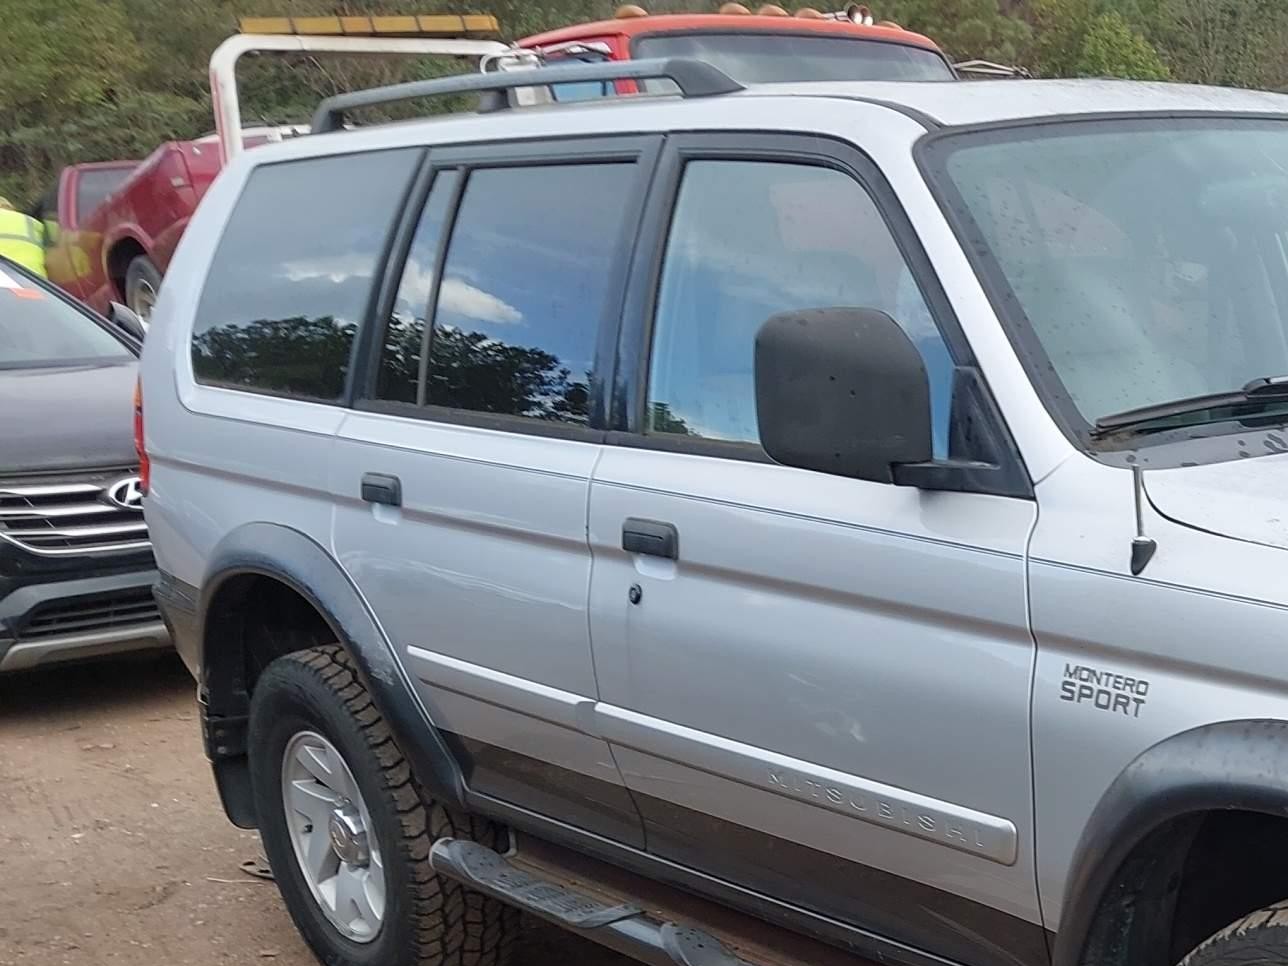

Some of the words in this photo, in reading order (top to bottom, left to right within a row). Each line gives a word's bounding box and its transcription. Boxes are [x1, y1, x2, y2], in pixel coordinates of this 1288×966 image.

[1059, 680, 1147, 719] SPORT
[1064, 663, 1150, 697] MONTERO
[766, 770, 986, 849] MITSUBISHI
